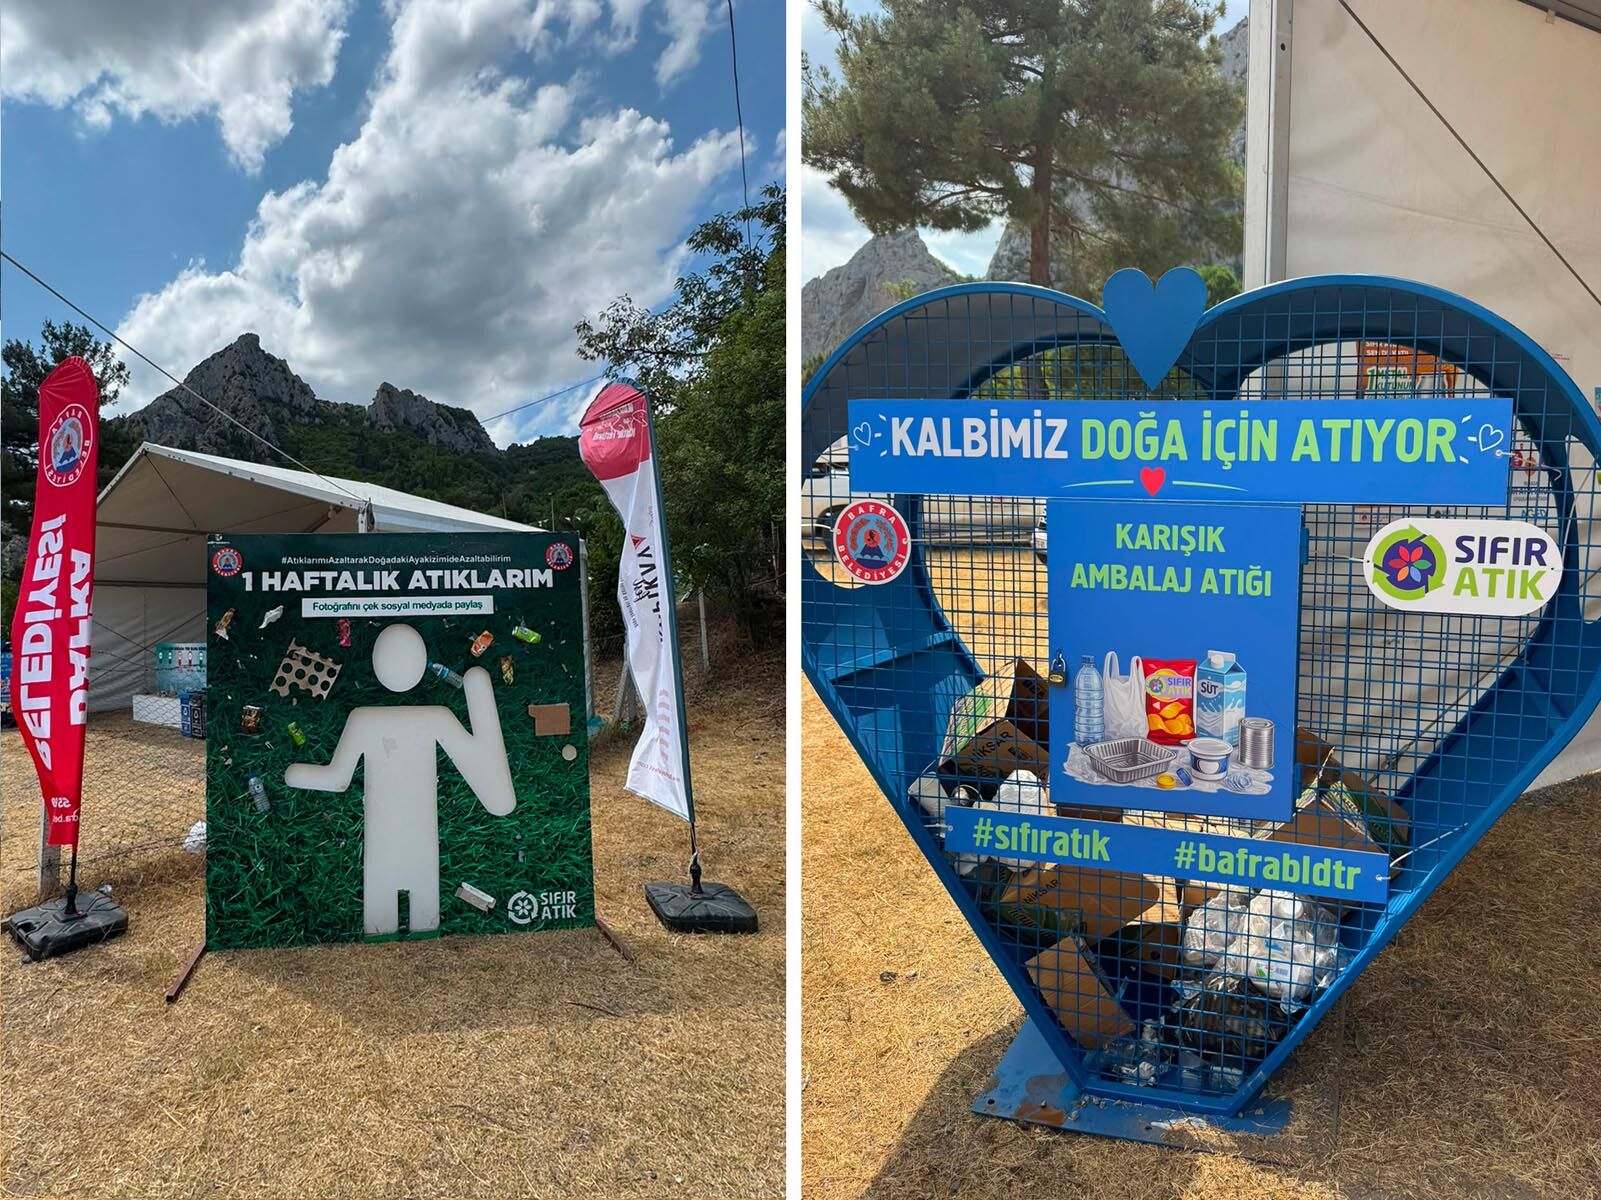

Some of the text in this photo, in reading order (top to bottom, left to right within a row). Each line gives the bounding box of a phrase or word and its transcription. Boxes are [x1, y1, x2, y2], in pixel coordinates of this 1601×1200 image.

[891, 408, 1457, 470] KALBİMİZ DOĞA İÇİN ATIYOR
[847, 504, 896, 524] BAFRA
[1116, 523, 1226, 557] KARIŞIK
[1455, 535, 1548, 566] SIFIR
[838, 544, 906, 580] BELEDİYESİ
[241, 568, 553, 592] 1 HAFTALIK ATIKLARIM
[1070, 563, 1272, 597] AMBALAJ ATIĞI
[1453, 567, 1546, 600] ATIK
[312, 600, 483, 613] Fotoğrafını çek sosyal medyada paylaş
[1168, 677, 1191, 687] SIFIR
[973, 817, 1110, 862] #sıfıratık
[1174, 841, 1361, 890] #bafrabldtr
[540, 890, 577, 906] SIFIR
[541, 904, 577, 920] ATIK
